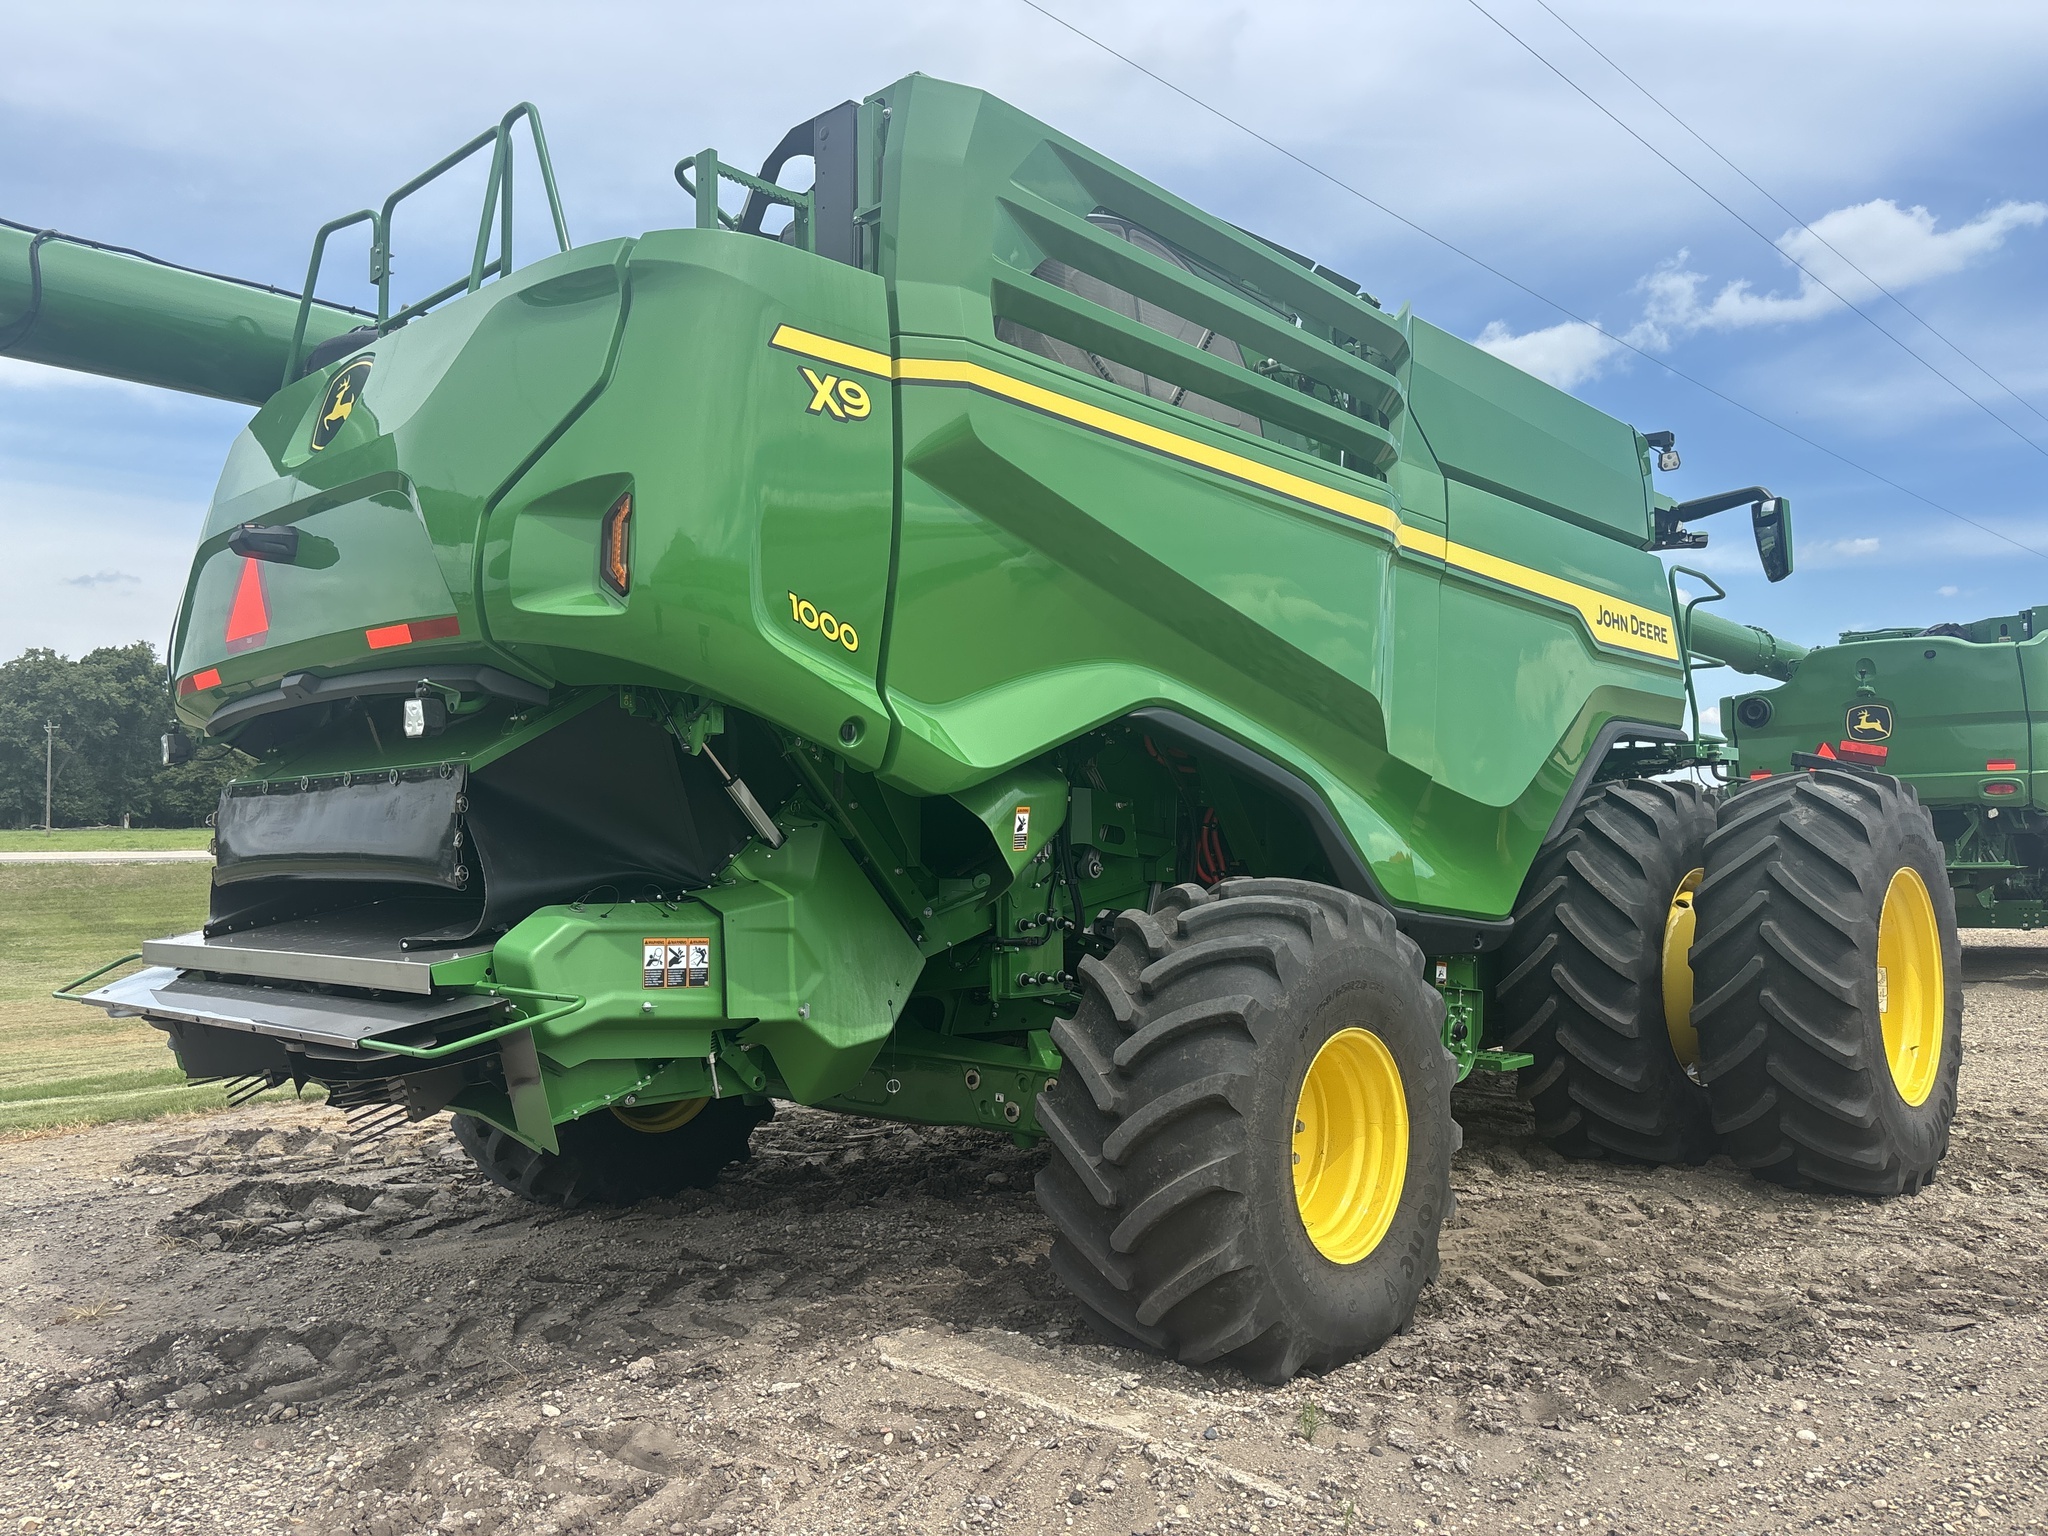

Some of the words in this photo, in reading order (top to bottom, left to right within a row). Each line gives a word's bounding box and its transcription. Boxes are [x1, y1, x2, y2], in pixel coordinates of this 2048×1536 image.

[798, 365, 872, 423] X9
[788, 590, 859, 652] 1000
[1596, 604, 1628, 633] JOHN
[1630, 614, 1668, 644] DEERE
